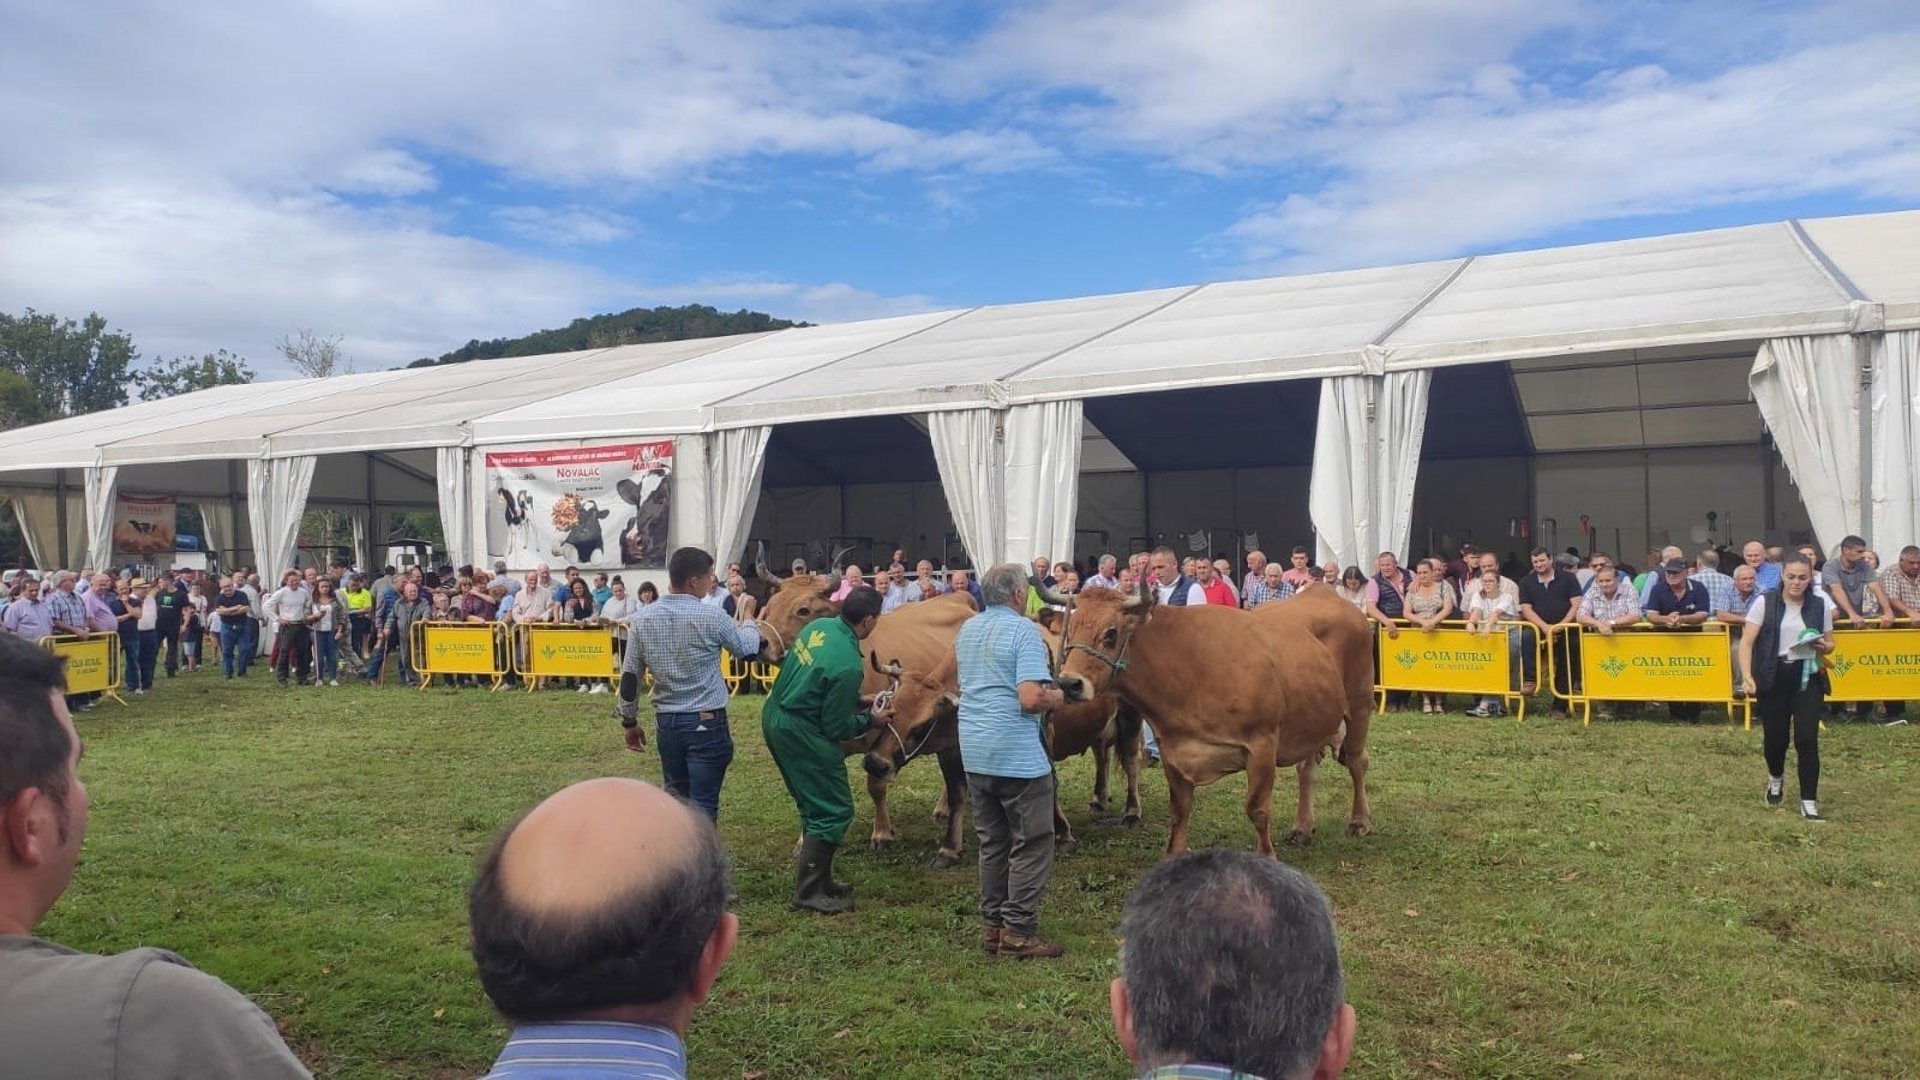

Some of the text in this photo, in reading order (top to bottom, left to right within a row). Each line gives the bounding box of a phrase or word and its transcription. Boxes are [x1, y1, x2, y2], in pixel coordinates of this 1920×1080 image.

[557, 467, 600, 478] NOVALAC
[1423, 650, 1495, 662] CAJA RURAL
[1631, 656, 1715, 667] CAJA RURAL
[1859, 654, 1920, 666] CAJA RUR
[1886, 668, 1920, 676] ASTURI
